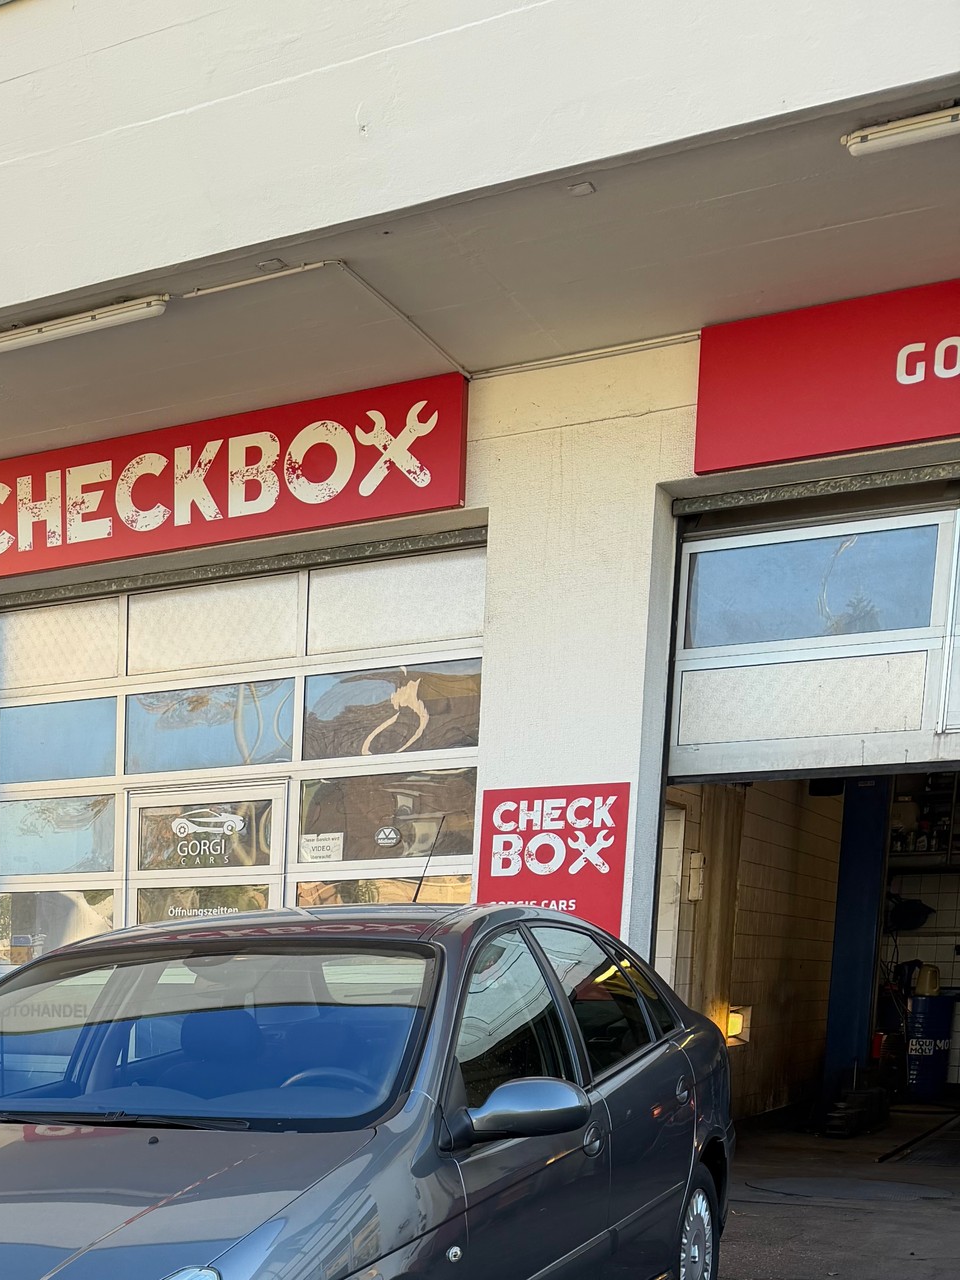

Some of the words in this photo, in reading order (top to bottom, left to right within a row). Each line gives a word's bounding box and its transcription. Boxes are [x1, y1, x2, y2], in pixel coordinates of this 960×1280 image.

[492, 796, 618, 832] CHECK
[177, 839, 225, 856] GORGI
[490, 830, 615, 877] BOX
[541, 899, 577, 911] CARS
